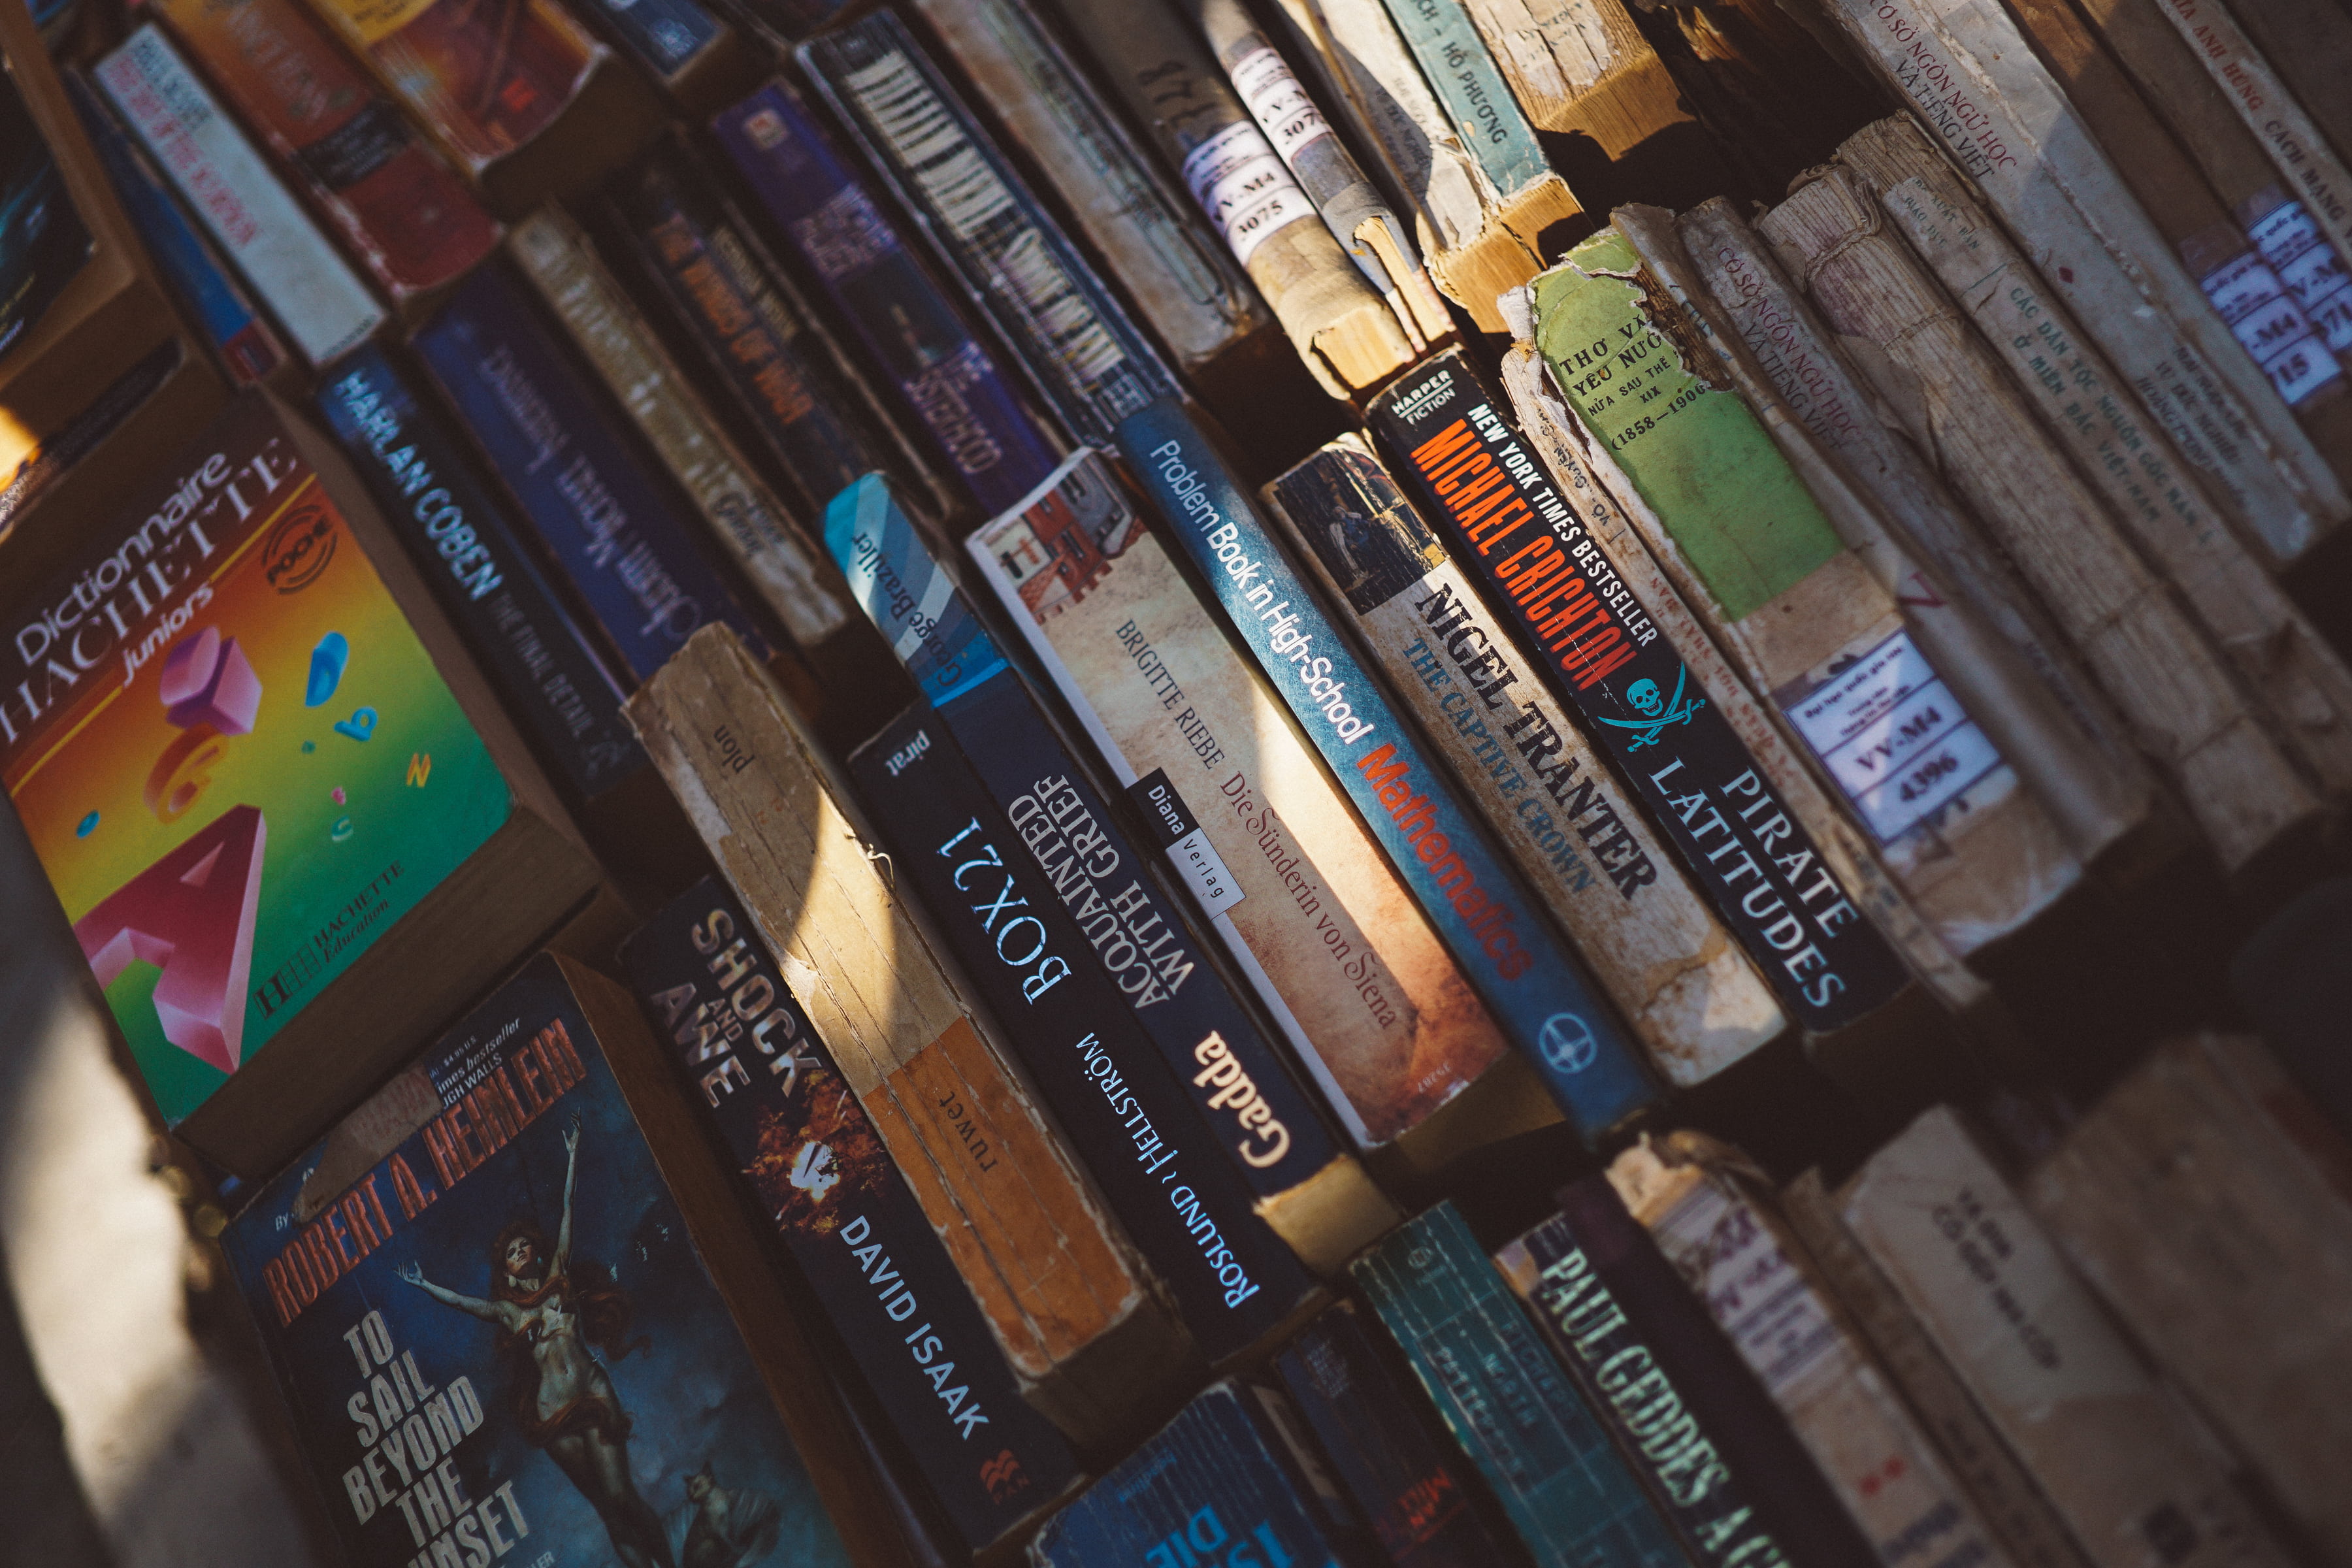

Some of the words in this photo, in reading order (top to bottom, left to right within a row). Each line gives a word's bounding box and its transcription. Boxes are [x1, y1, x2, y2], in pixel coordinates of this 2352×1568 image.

[1893, 57, 1923, 88] VÀ
[2193, 25, 2227, 59] ANH
[1282, 112, 1321, 143] 307
[1458, 70, 1508, 145] PHƯƠNG
[1907, 37, 1957, 94] NGÔN
[1946, 86, 1991, 135] NGỮ
[1974, 129, 2017, 176] HỌC
[1237, 200, 1283, 237] 3075
[1560, 338, 1608, 376] THƠ
[1618, 314, 1646, 339] VĂ
[1741, 322, 1771, 355] VÀ
[1752, 295, 1803, 355] NGÔN
[1789, 350, 1835, 401] NGỮ
[2008, 282, 2044, 322] CÁC
[1391, 368, 1452, 418] HARPER
[1406, 386, 1456, 425] FICTION
[1573, 365, 1612, 397] YÊU
[1619, 376, 1642, 396] SAU
[1640, 386, 1661, 403] XIX
[335, 370, 435, 498] HARLAN
[414, 488, 502, 601] COBEN
[1465, 402, 1506, 449] NEW
[1503, 440, 1544, 491] YORK
[1531, 482, 1582, 544] TIMES
[1573, 531, 1657, 647] BESTSELLER
[0, 436, 299, 743] HACHETTE
[15, 451, 231, 668] Dictionnaire
[854, 533, 915, 621] Braziller
[1150, 438, 1222, 532] Problem
[1207, 522, 1262, 592] Book
[1247, 580, 1275, 615] in
[1264, 598, 1377, 745] High-School
[1411, 418, 1535, 557] MICHAEL
[1495, 531, 1637, 693] CRICHTON
[124, 581, 214, 687] juniors
[542, 672, 594, 739] DETAIL
[713, 726, 755, 775] plon
[883, 730, 930, 778] pirat
[1415, 583, 1520, 710] NIGEL
[1502, 700, 1658, 902] TRANTER
[1856, 706, 1941, 770] VV-M4
[1148, 785, 1184, 835] Diana
[1403, 637, 1450, 693] THE
[1440, 690, 1527, 798] CAPTIVE
[1516, 798, 1598, 894] CROWN
[1901, 751, 1957, 801] 4396
[1034, 774, 1119, 878] GRIEF
[1115, 619, 1185, 711] BRIGITTE
[1175, 704, 1226, 771] RIEBE
[1221, 770, 1257, 820] Die
[1245, 804, 1320, 919] Sünderin
[1315, 907, 1354, 962] von
[1344, 947, 1398, 1030] Siena
[1356, 742, 1533, 981] Mathematics
[1720, 766, 1858, 938] PIRATE
[314, 860, 404, 949] HACHETTE
[321, 897, 390, 964] Education
[1008, 794, 1169, 1008] ACQUAINTED
[1648, 757, 1847, 1008] LATITUDES
[971, 874, 1071, 1005] BOX
[1110, 879, 1194, 994] WITH
[649, 981, 753, 1109] AWE
[691, 909, 825, 1096] SHOCK
[706, 999, 745, 1042] AND
[437, 1068, 466, 1094] imes
[466, 1017, 521, 1070] bestseller
[465, 1052, 502, 1088] WALLS
[1075, 1032, 1178, 1175] HELLSTRÖM
[1195, 1030, 1290, 1169] Gadda
[263, 1173, 393, 1328] ROBERT
[389, 1152, 438, 1222] A.
[421, 1018, 587, 1190] HEINLEIN
[939, 1092, 999, 1173] ruwet
[1170, 1185, 1260, 1309] ROSLUND
[343, 1311, 394, 1379] TO
[840, 1215, 916, 1323] DAVID
[905, 1323, 990, 1441] ISAAK
[347, 1350, 435, 1448] SAIL
[1541, 1247, 1629, 1362] PAUL
[1595, 1345, 1731, 1508] GEDDES
[342, 1375, 484, 1526] BEYOND
[395, 1456, 472, 1548] THE
